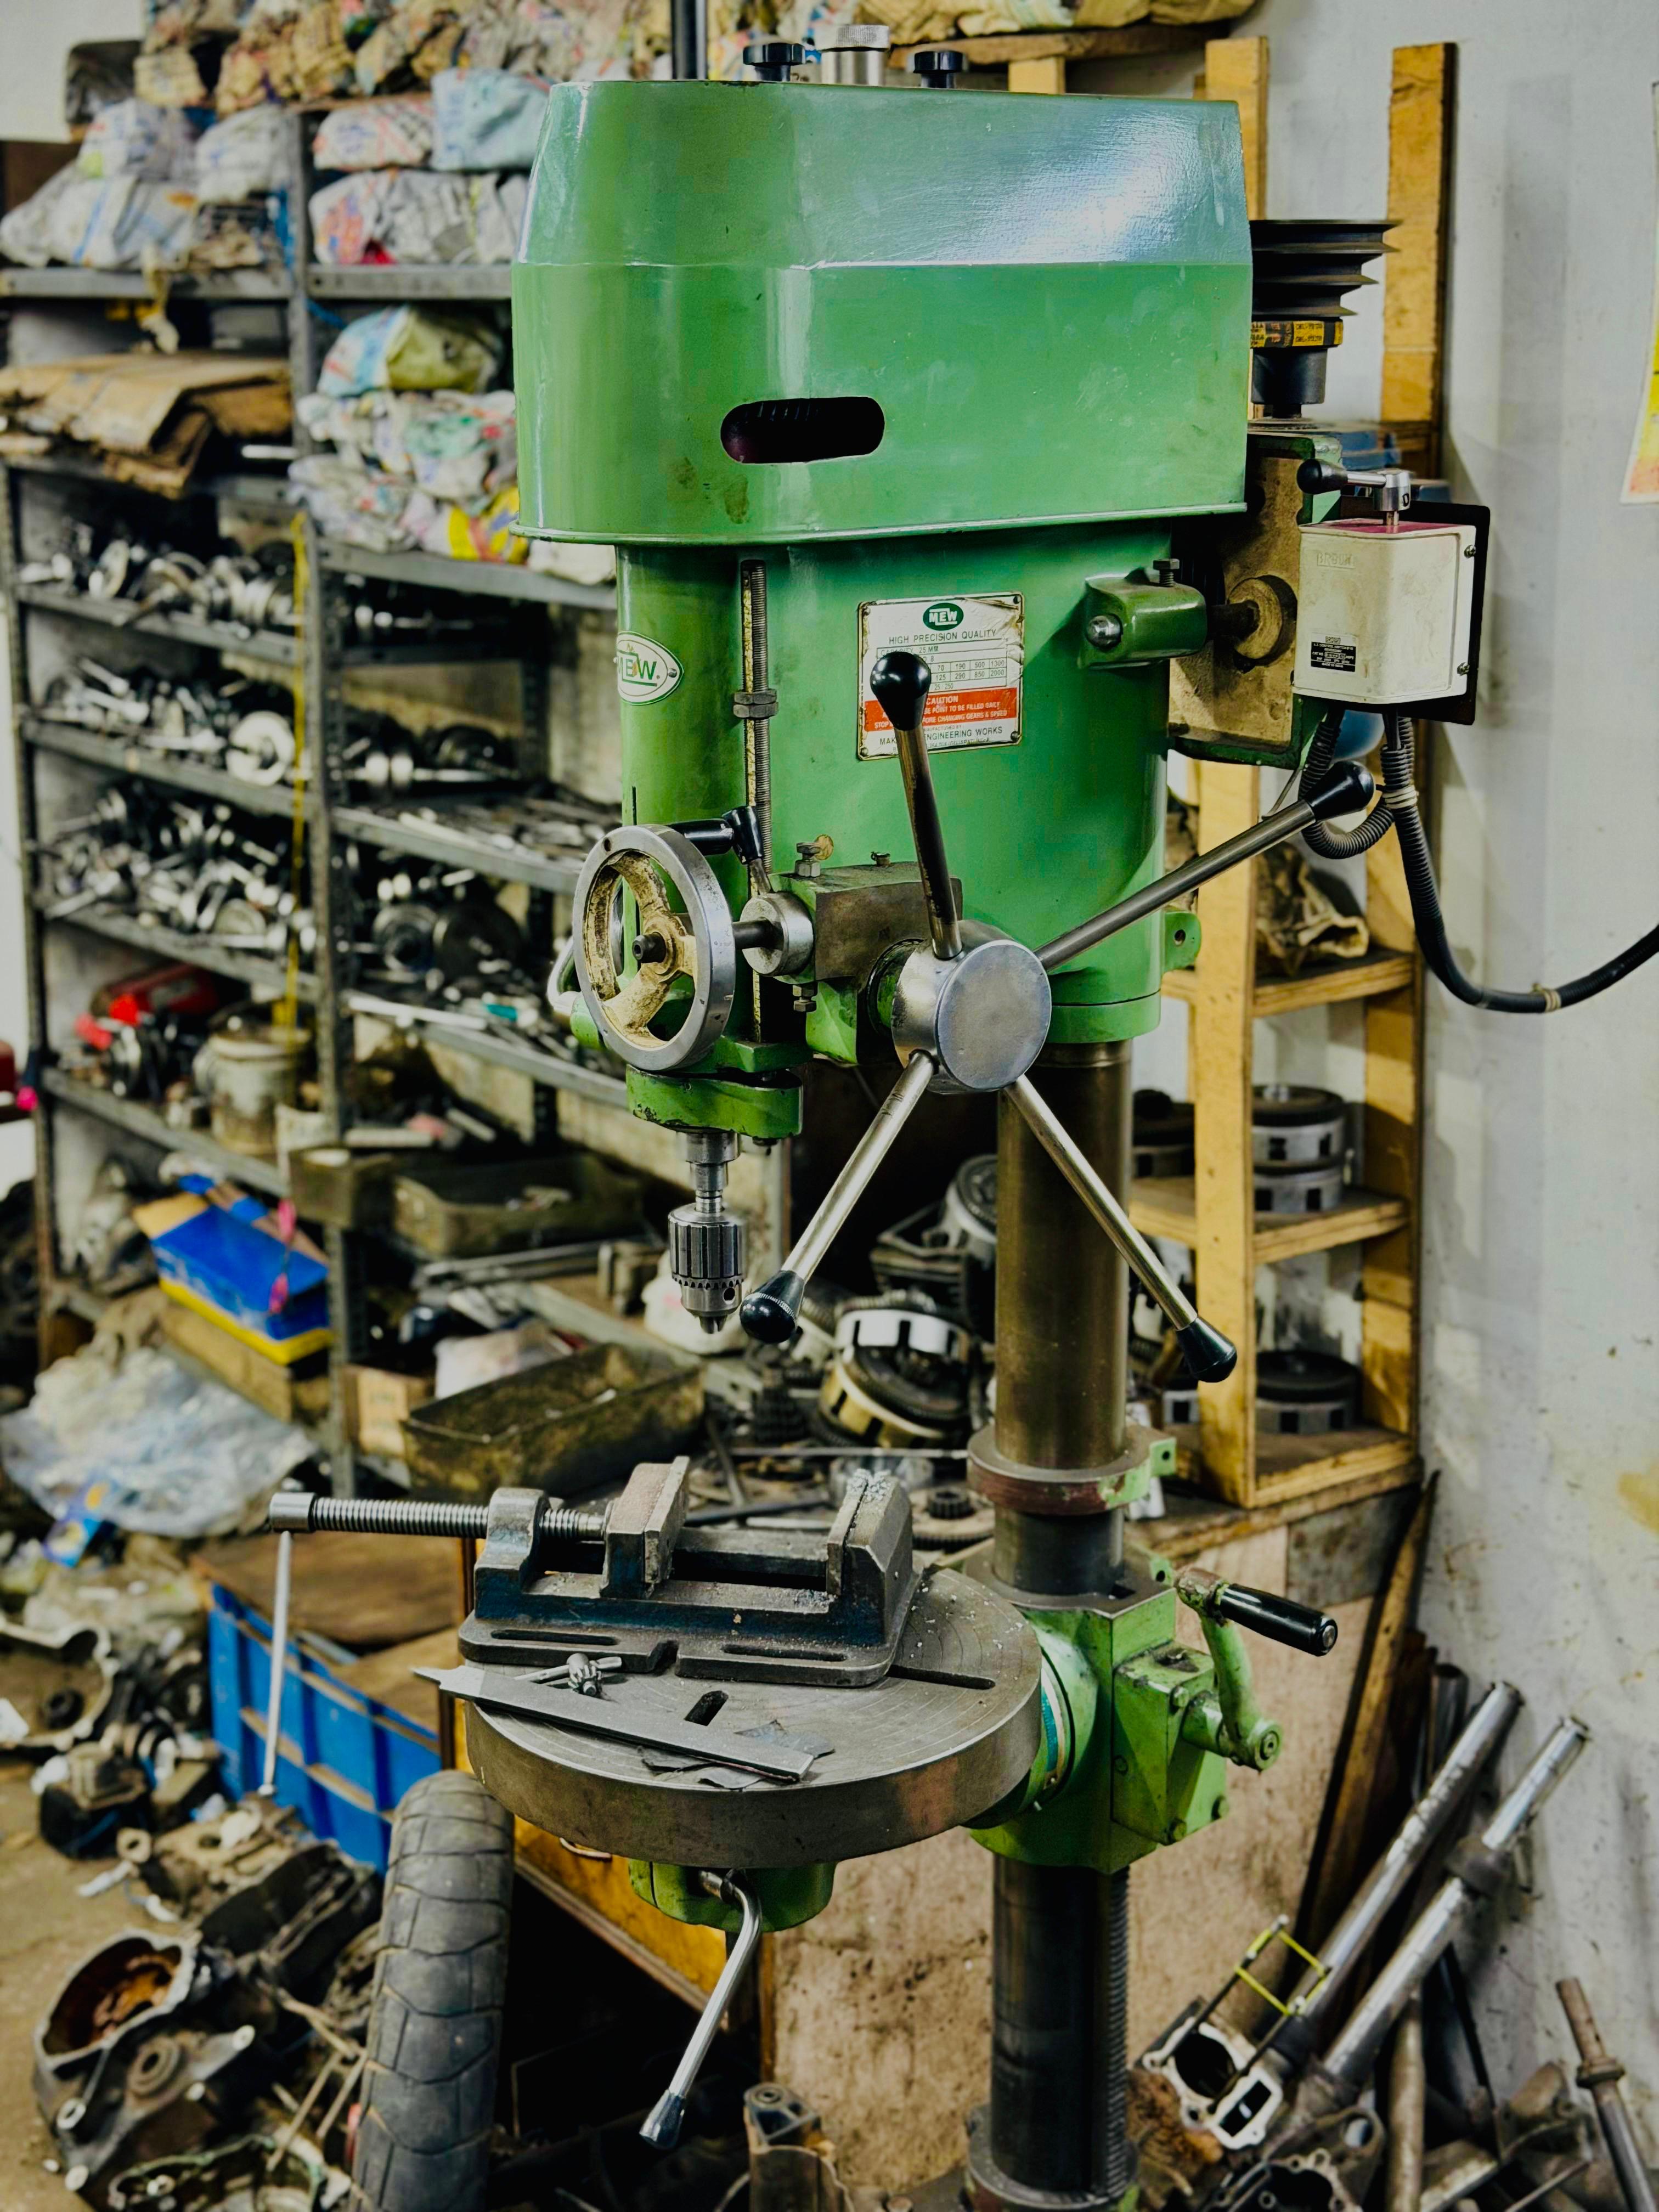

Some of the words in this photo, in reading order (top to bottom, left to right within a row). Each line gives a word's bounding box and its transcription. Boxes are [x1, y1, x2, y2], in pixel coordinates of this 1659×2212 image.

[929, 608, 957, 625] MEW
[889, 636, 909, 645] HIGH
[914, 632, 957, 643] PRECISION
[962, 629, 996, 639] QUALITY
[926, 696, 958, 706] CAUTION
[933, 706, 948, 714] POINT
[938, 714, 966, 723] CHANGING
[924, 730, 972, 740] NGINEERING
[975, 726, 1002, 735] WORKS
